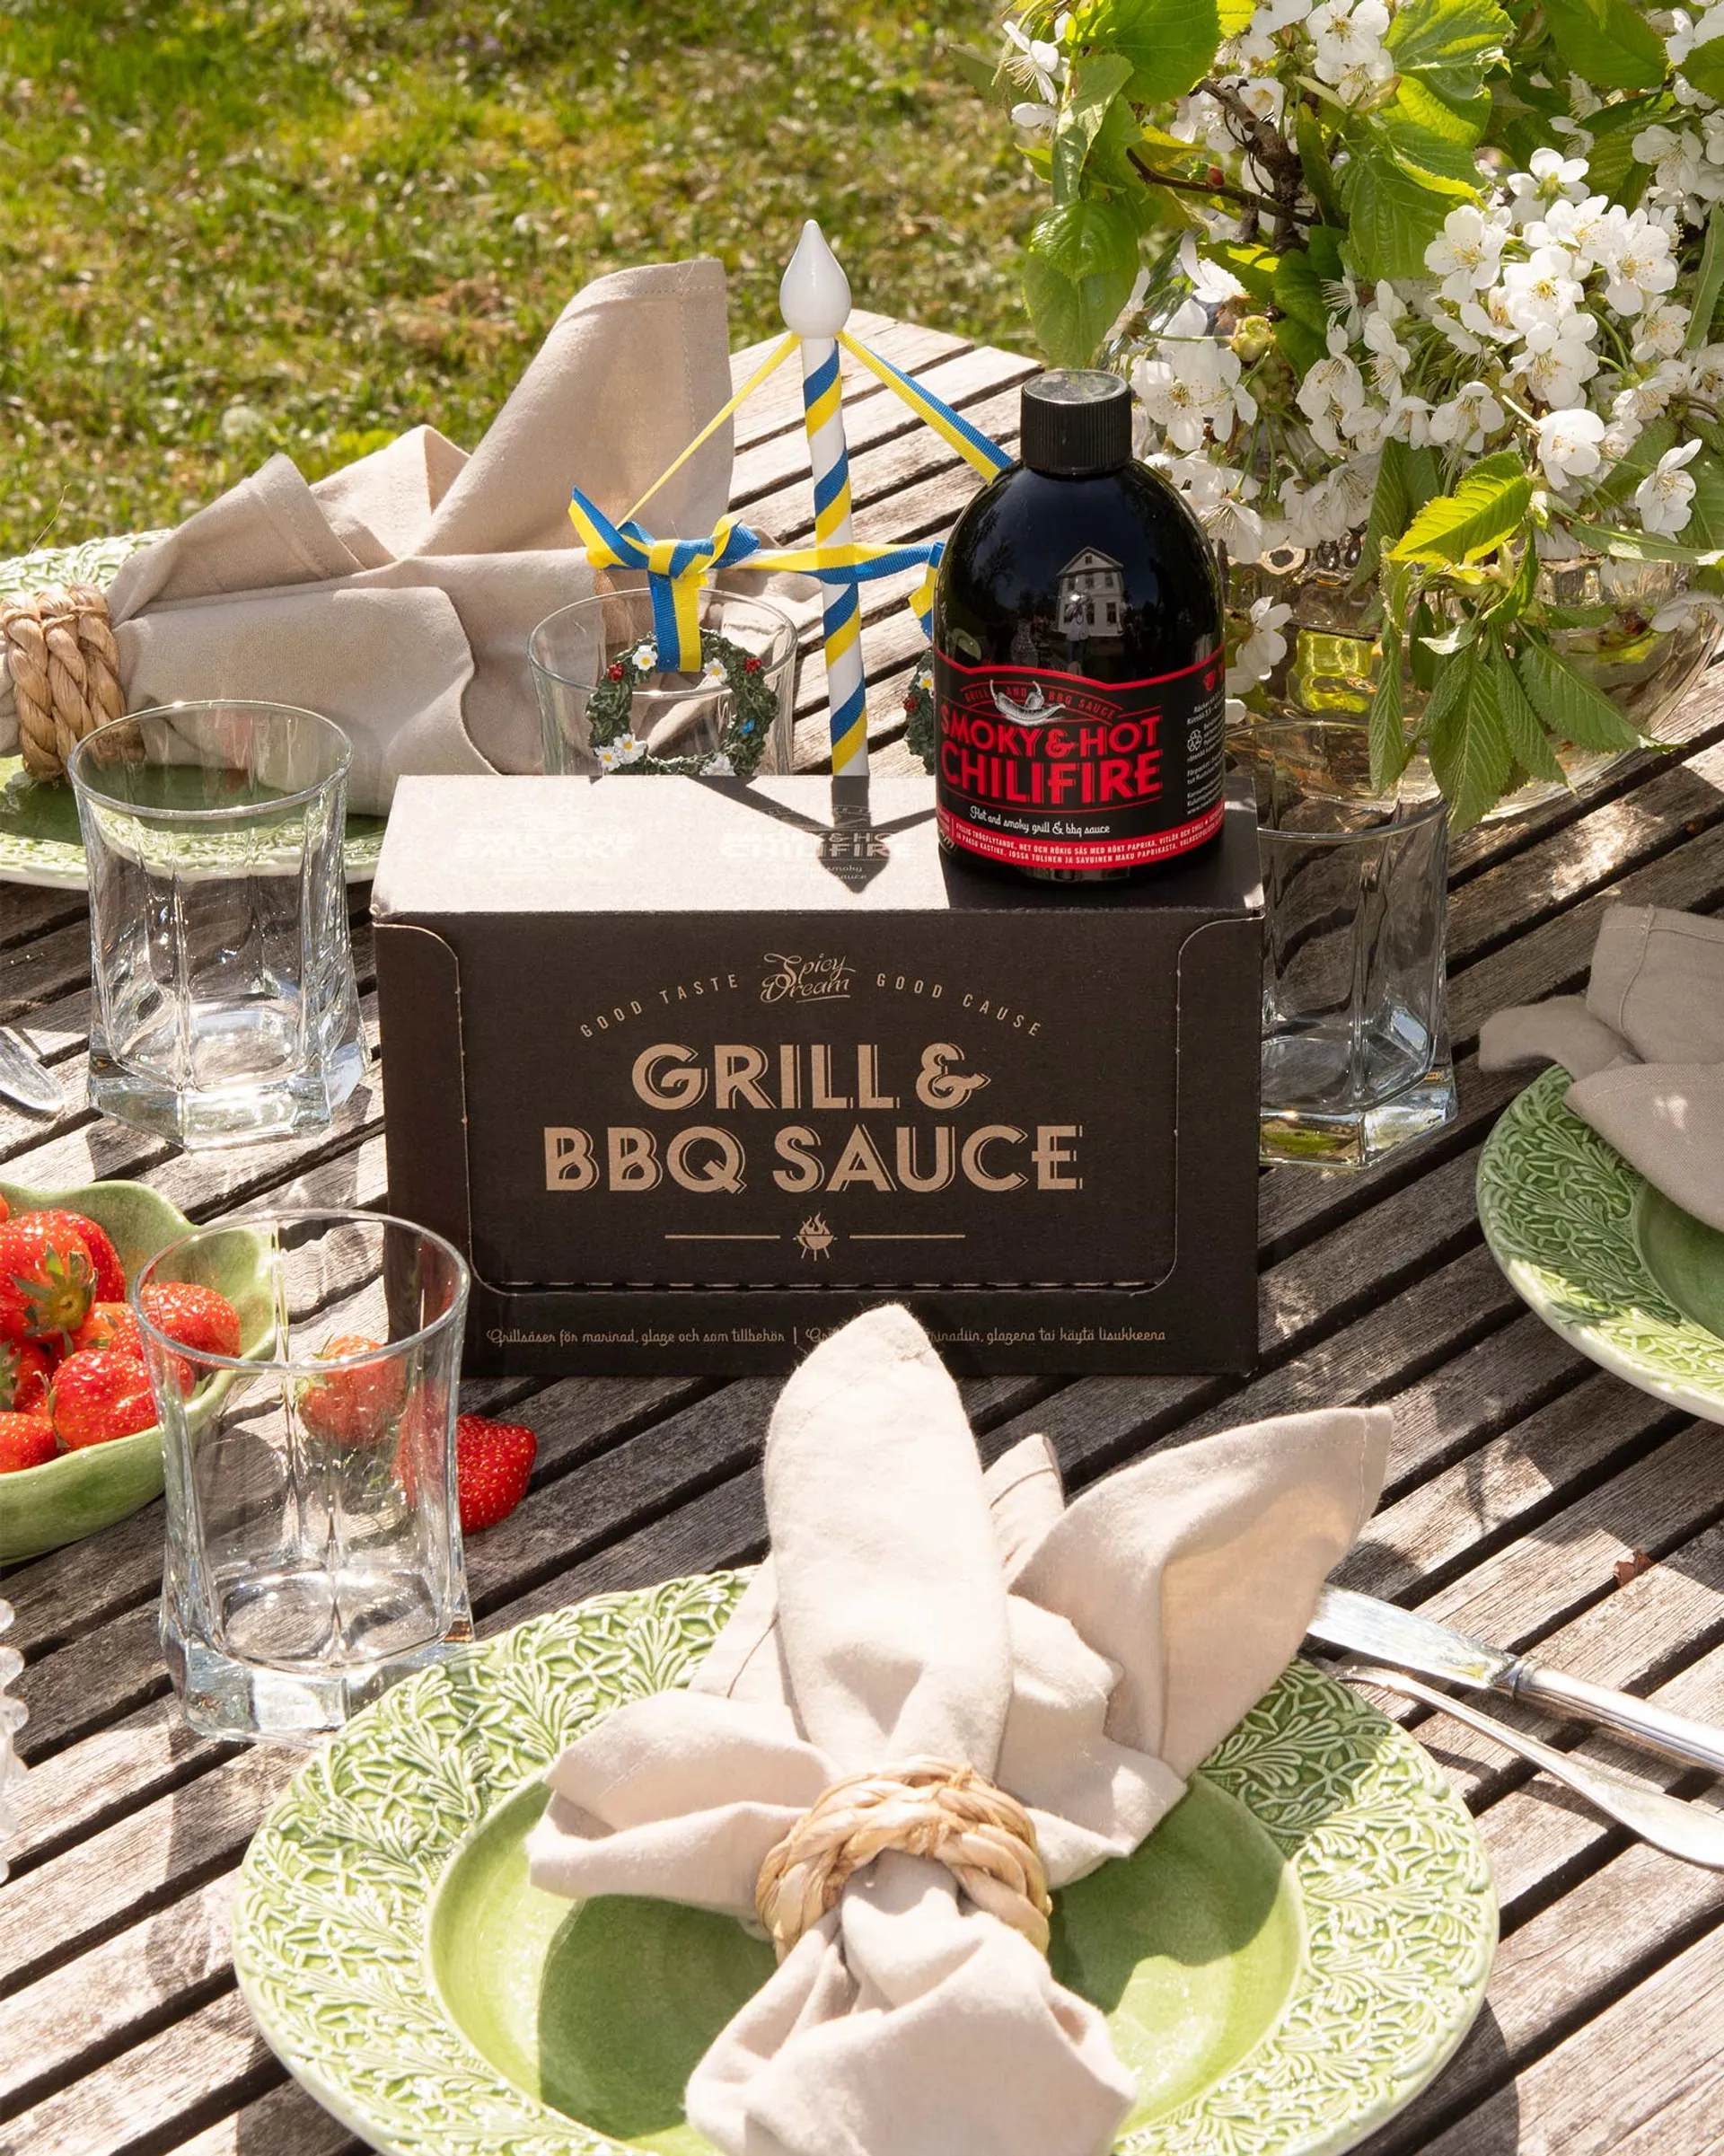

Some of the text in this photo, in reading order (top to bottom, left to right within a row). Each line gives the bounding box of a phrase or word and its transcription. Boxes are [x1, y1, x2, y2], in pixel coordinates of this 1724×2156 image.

[1049, 691, 1071, 704] BBQ
[1078, 699, 1115, 718] SAUCE
[941, 704, 1042, 757] SMOKY
[1045, 728, 1077, 758] &
[1080, 715, 1162, 757] HOT
[943, 740, 1162, 804] CHILIFIRE
[970, 805, 1110, 838] Hot and smoky grill & bbq sauce
[1034, 845, 1047, 853] OCH
[1090, 846, 1104, 854] MED
[763, 953, 857, 987] Spicy
[580, 973, 738, 1037] GOOD TASTE
[760, 974, 851, 1004] Dream
[876, 972, 1041, 1036] GOOD CAUSE
[632, 1043, 991, 1110] GRILL &
[543, 1123, 1083, 1194] BBQ SAUCE
[486, 1328, 785, 1347] Grillsåser för marinad, glaze och som tillbehör
[928, 1327, 1165, 1346] rinadiin, glazena tai käytä lisukkeena
